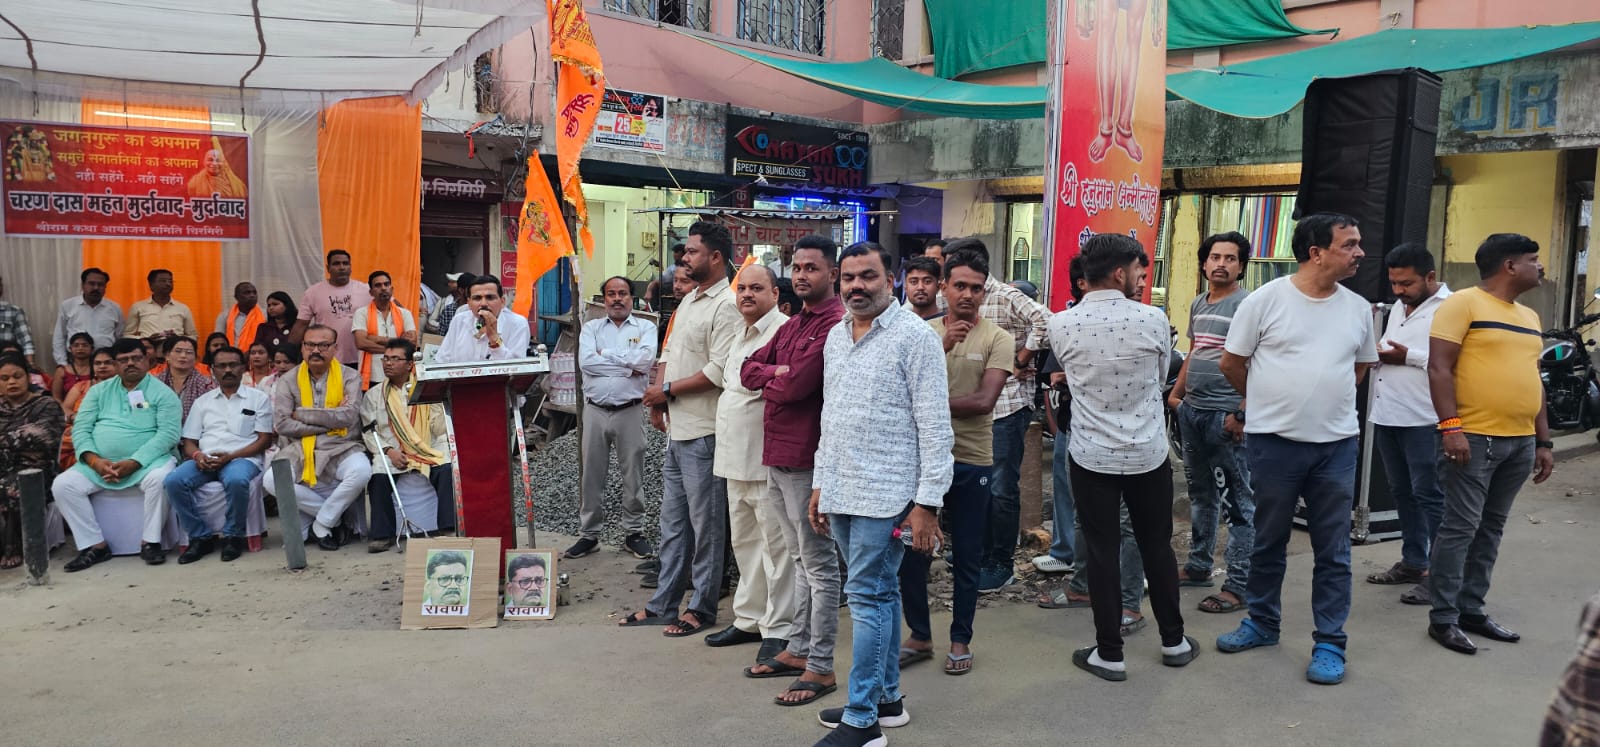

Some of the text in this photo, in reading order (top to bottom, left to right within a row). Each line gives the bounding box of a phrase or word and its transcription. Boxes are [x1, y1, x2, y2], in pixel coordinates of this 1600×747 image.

[617, 116, 631, 133] 25
[124, 134, 145, 147] का
[151, 136, 201, 150] अपमान
[145, 157, 160, 168] का
[164, 158, 199, 169] अपमान
[736, 161, 807, 178] SPECT & SUNGLASSES
[1061, 163, 1078, 207] श्री
[8, 191, 50, 211] चरण
[51, 192, 84, 214] दास
[86, 187, 124, 216] महंत
[102, 224, 146, 234] आयोजन
[150, 225, 182, 234] समिति
[756, 224, 781, 241] चाट
[424, 604, 464, 615] रावण
[507, 606, 545, 616] रावण
